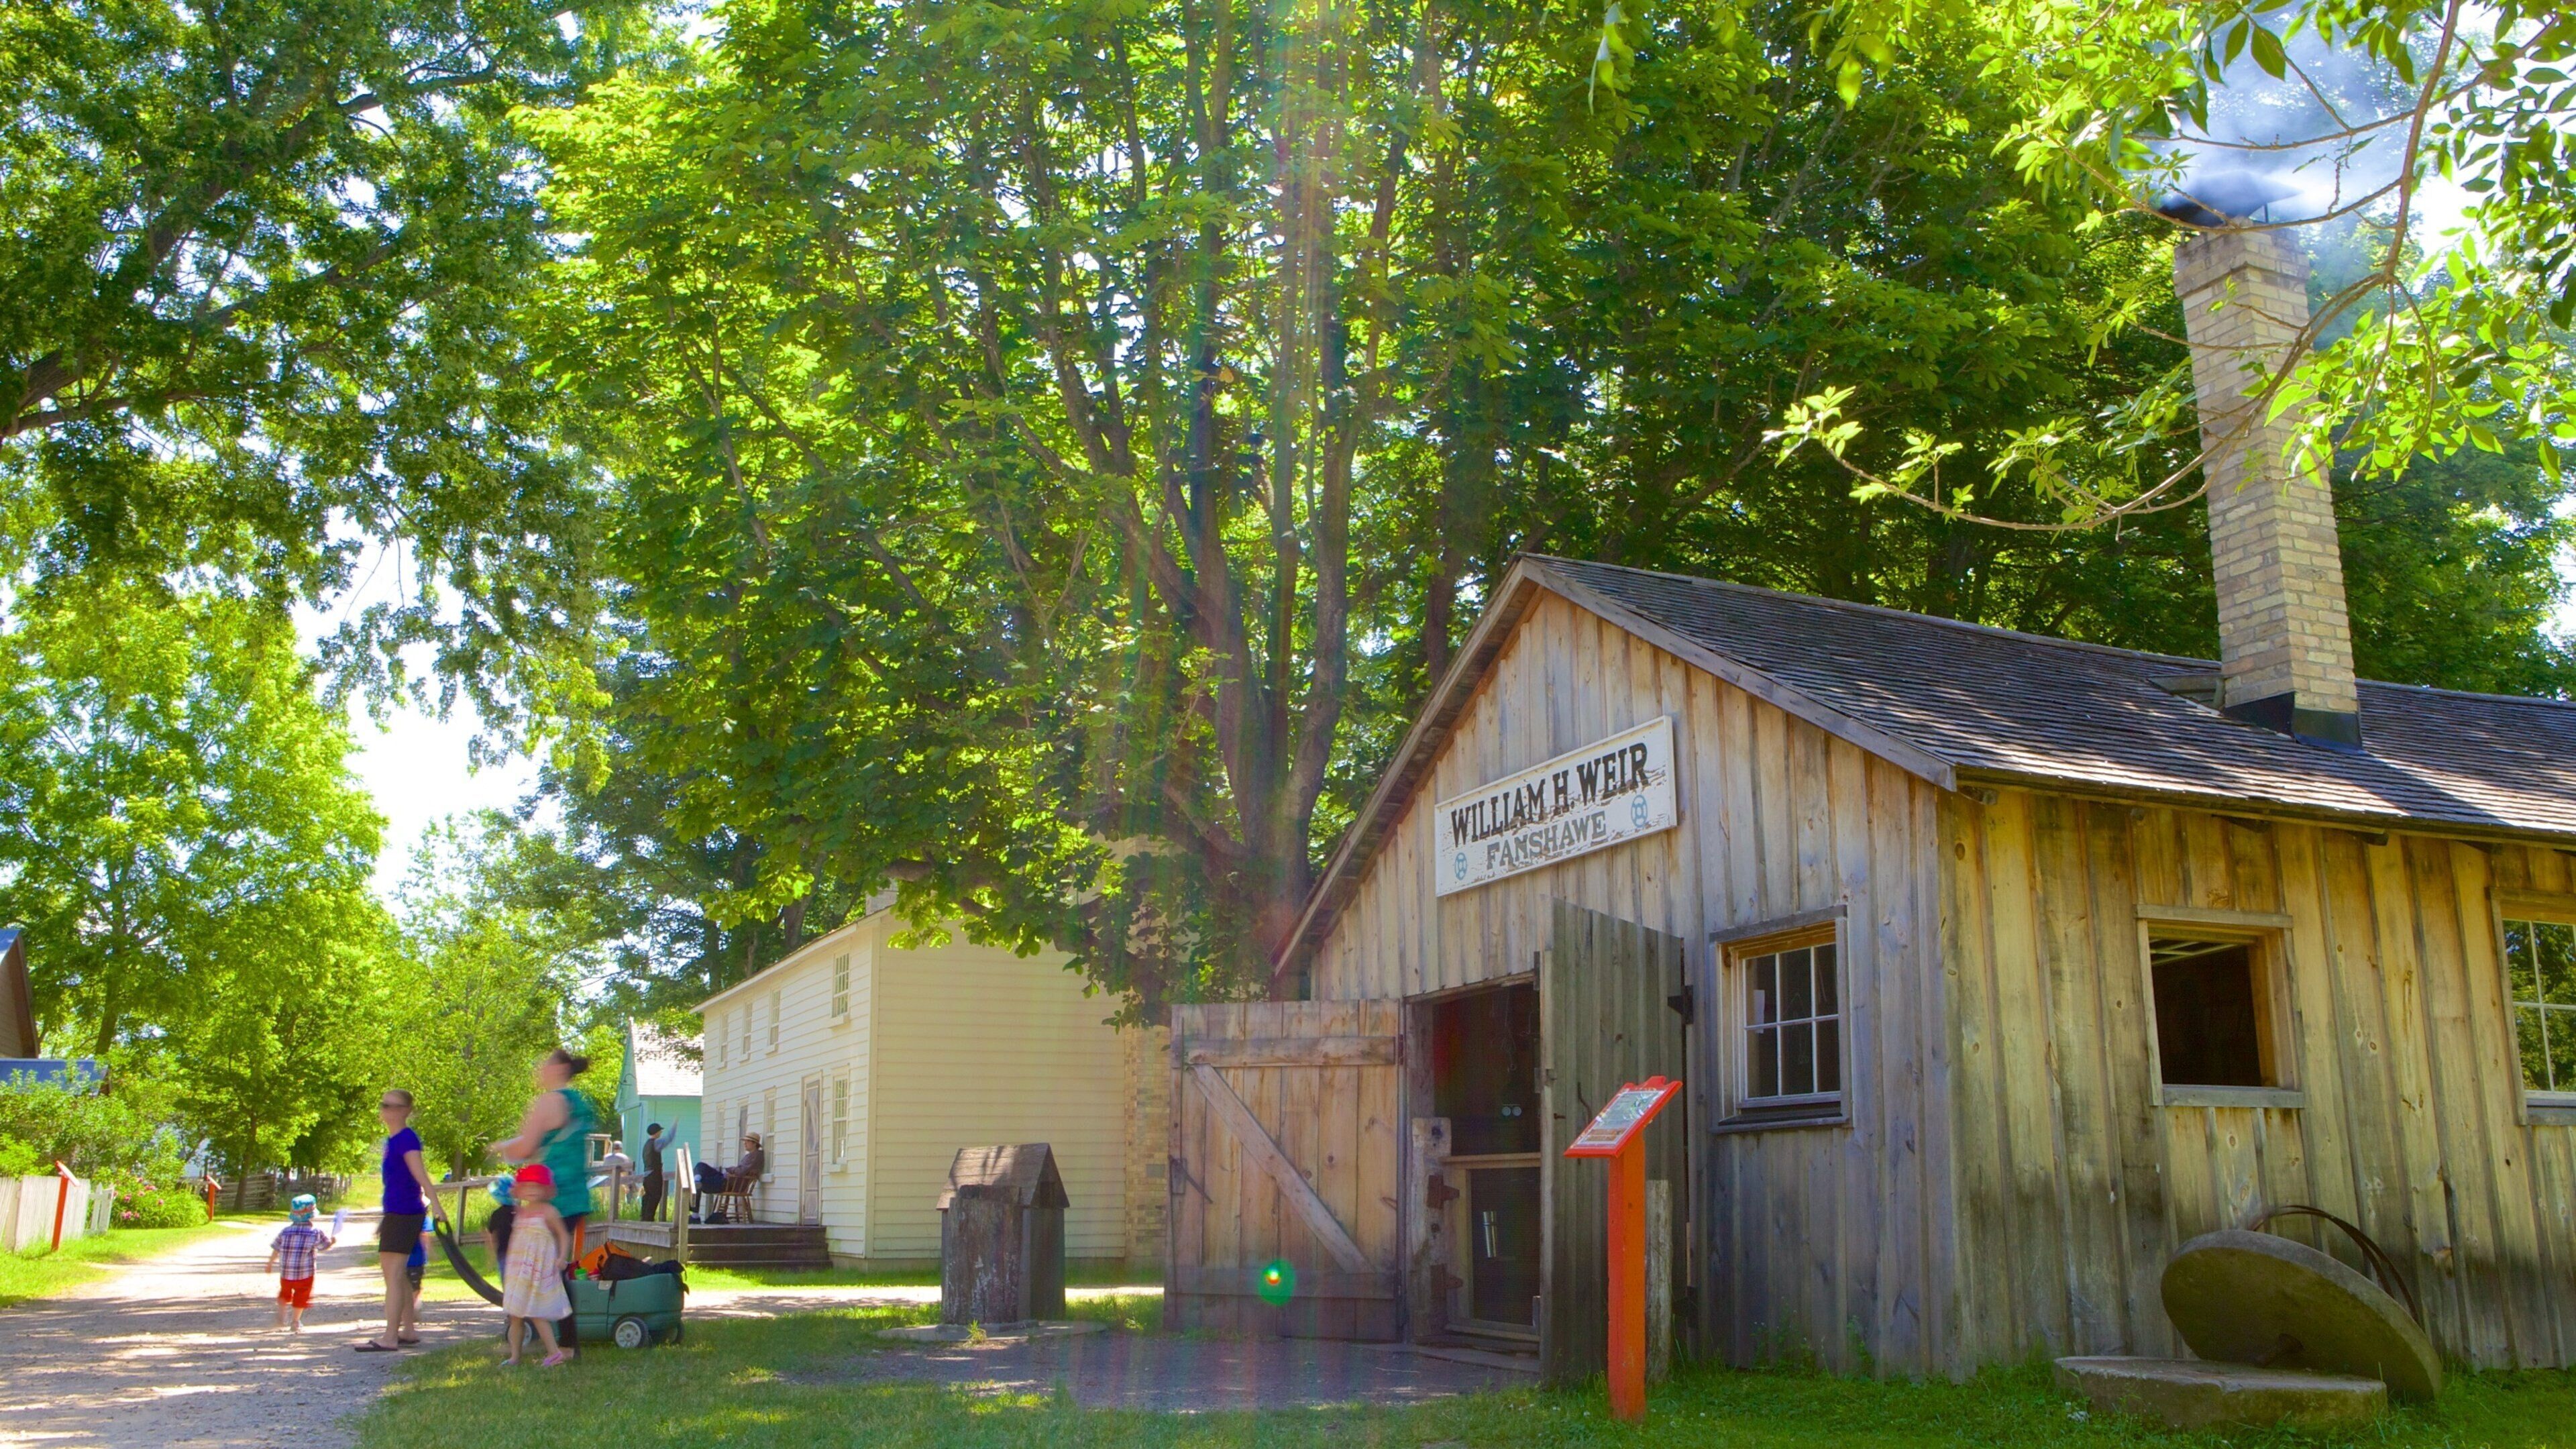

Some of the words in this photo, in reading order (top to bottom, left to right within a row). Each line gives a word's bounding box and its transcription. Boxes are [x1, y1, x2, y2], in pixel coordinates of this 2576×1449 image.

[1451, 778, 1546, 847] WILLIAM
[1576, 742, 1649, 806] WEIR
[1487, 810, 1607, 870] FANSHAWE
